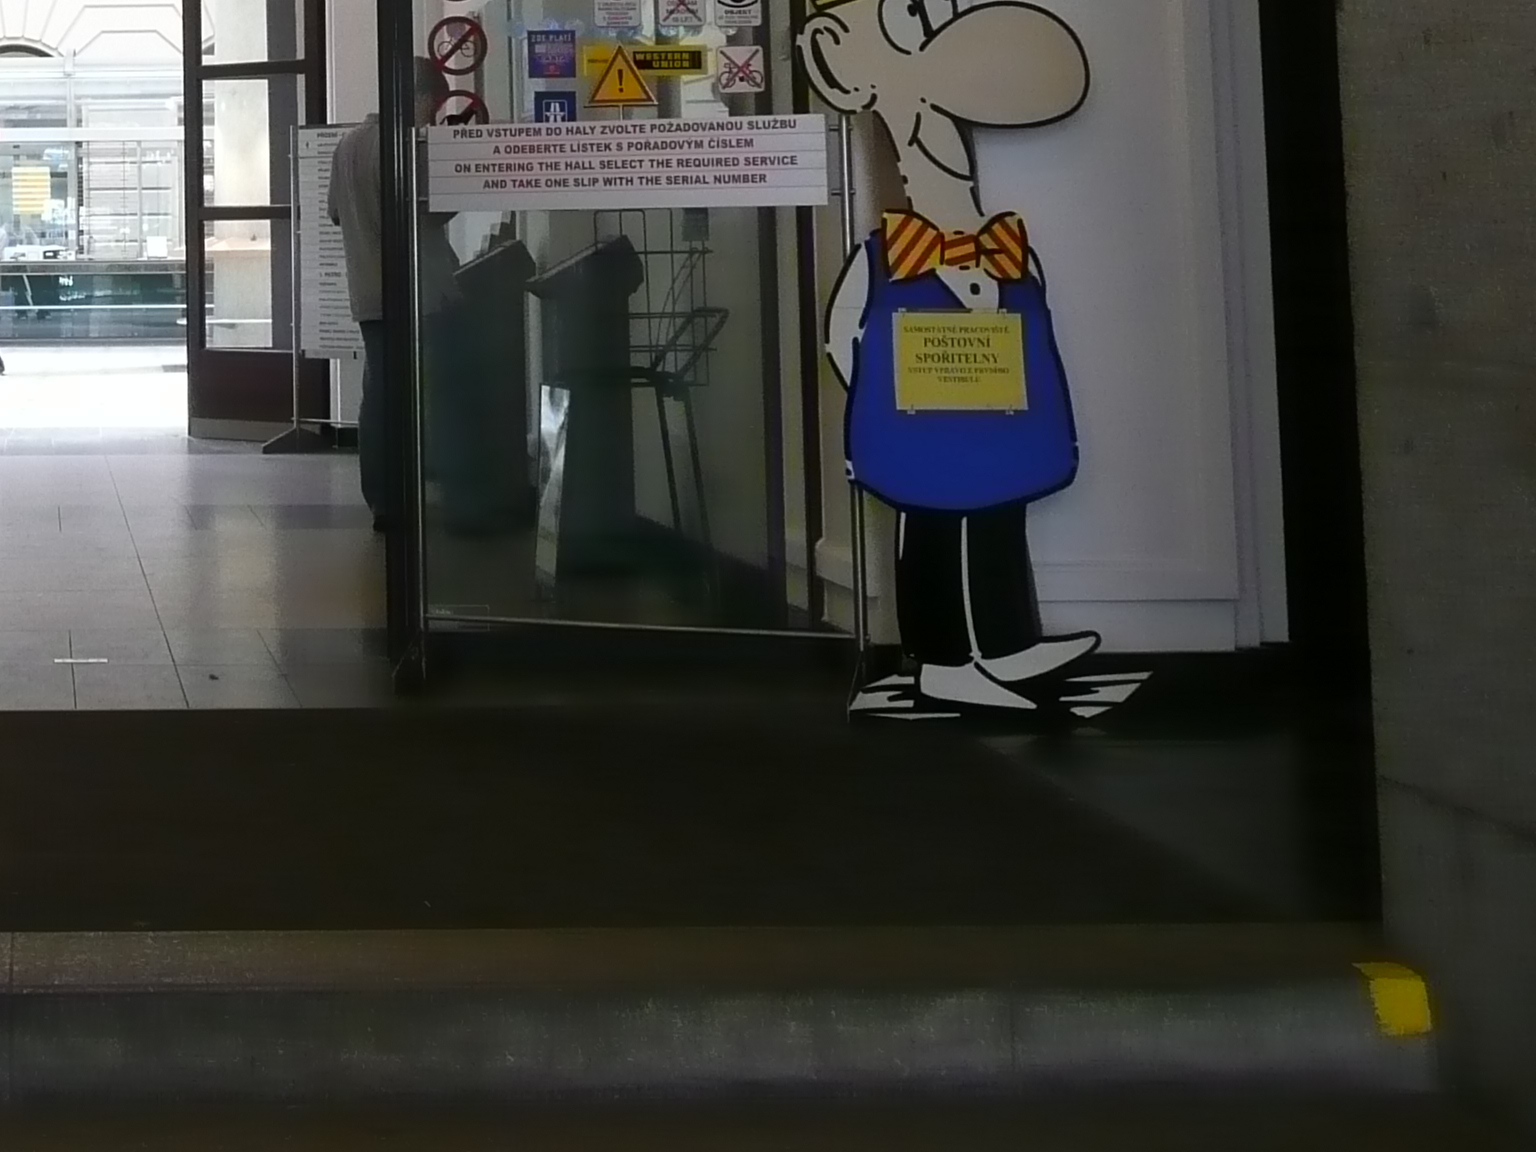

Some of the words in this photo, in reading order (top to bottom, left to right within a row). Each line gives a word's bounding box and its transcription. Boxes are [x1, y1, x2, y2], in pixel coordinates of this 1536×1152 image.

[635, 52, 690, 61] WESTERN
[652, 60, 690, 68] UNION
[453, 127, 483, 139] PŘED
[486, 127, 542, 139] VSTUPEM
[546, 126, 562, 137] DO
[566, 125, 596, 137] HALY
[600, 124, 646, 135] ZVOLTE
[650, 120, 743, 134] POŽADOVANOU
[747, 118, 797, 131] SLUŽBU
[493, 145, 501, 155] A
[504, 143, 565, 155] ODEBERTE
[570, 141, 612, 154] LÍSTEK
[616, 142, 623, 152] S
[627, 137, 704, 152] POŘADOVÝM
[708, 136, 754, 149] ČÍSLEM
[454, 163, 471, 173] ON
[475, 162, 534, 173] ENTERING
[537, 161, 561, 172] THE
[565, 160, 595, 172] HALL
[599, 159, 644, 170] SELECT
[648, 158, 672, 169] THE
[676, 157, 740, 168] REQUIRED
[744, 155, 798, 166] SERVICE
[483, 179, 507, 190] AND
[511, 178, 542, 189] TAKE
[545, 178, 570, 188] ONE
[573, 177, 599, 187] SLIP
[603, 176, 634, 187] WITH
[638, 175, 662, 186] THE
[666, 174, 709, 186] SERIAL
[714, 173, 767, 184] NUMBER
[923, 335, 991, 348] POŠTOVNÍ
[915, 350, 999, 364] SPOŘITELNY
